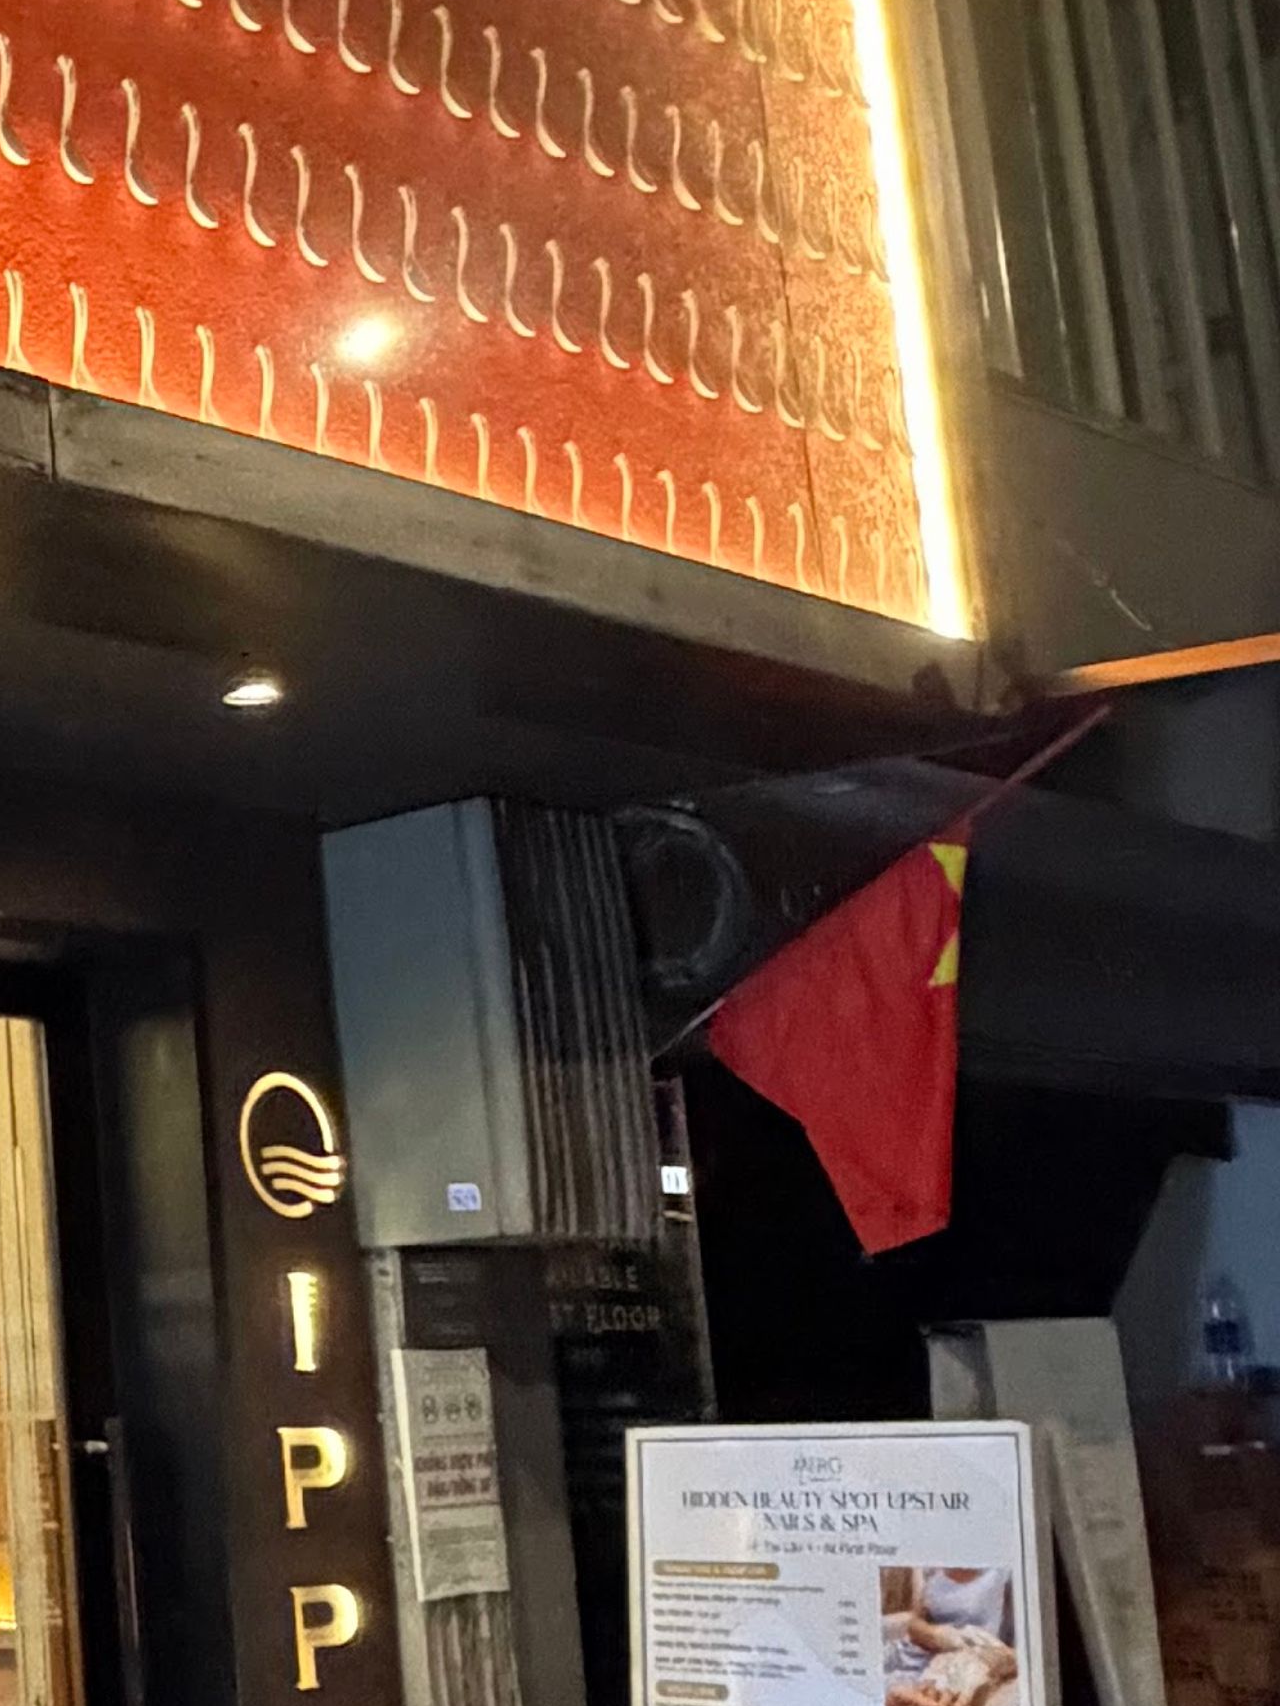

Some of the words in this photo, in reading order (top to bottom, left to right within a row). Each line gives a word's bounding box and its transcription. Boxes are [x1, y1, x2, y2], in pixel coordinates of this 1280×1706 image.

[682, 1491, 748, 1508] HIDDEN
[753, 1491, 822, 1510] BEAUTY
[831, 1492, 880, 1510] SPOT
[888, 1492, 971, 1511] UPSTAIR
[763, 1513, 816, 1532] NAILS
[820, 1514, 836, 1531] &
[841, 1513, 879, 1533] SPA
